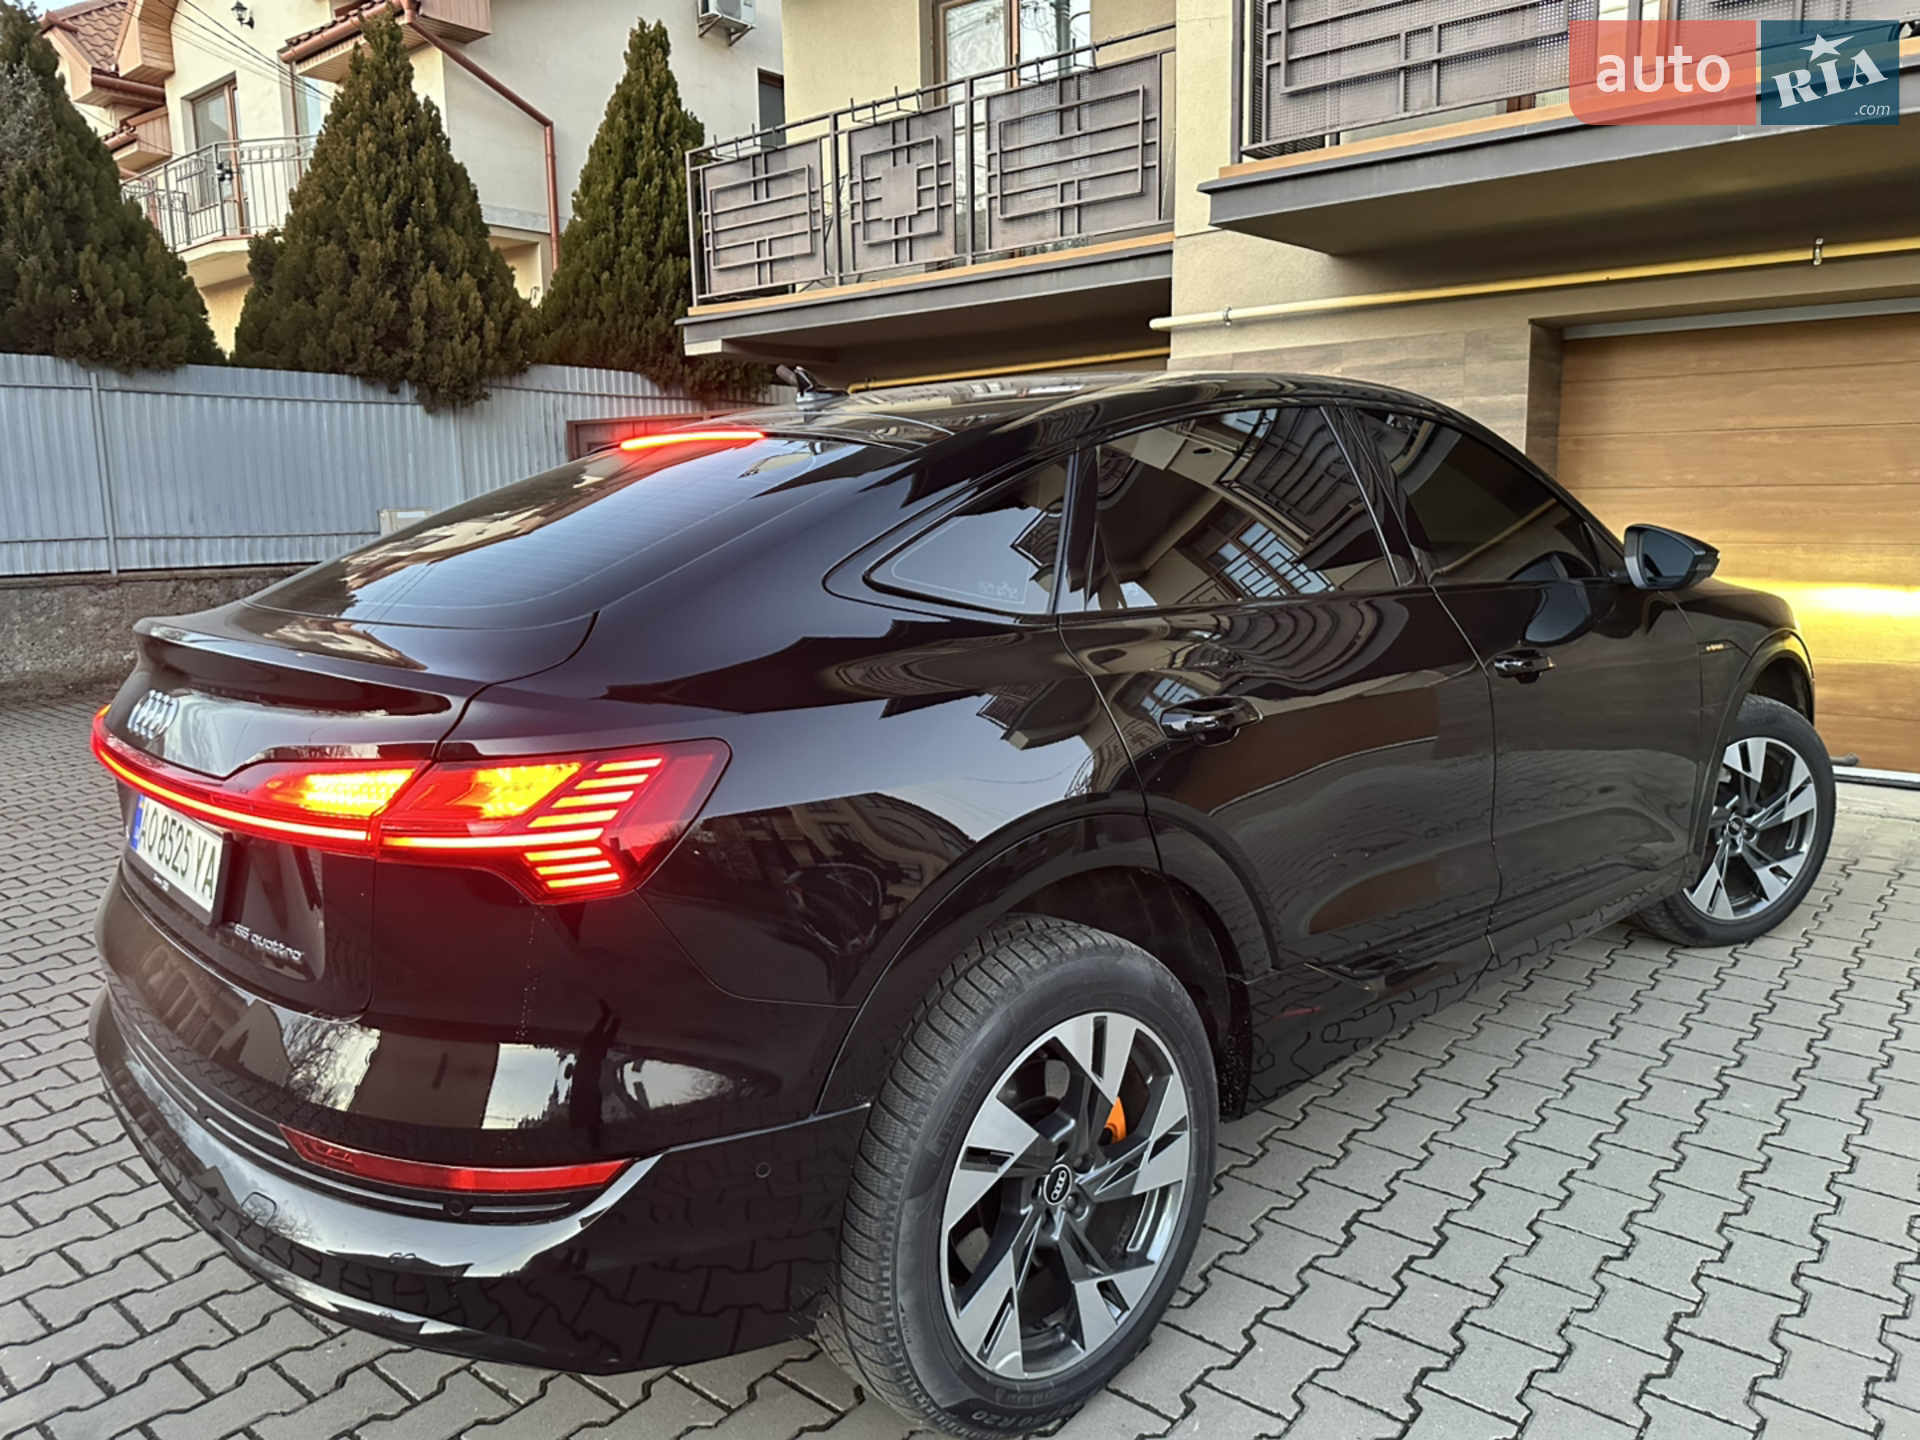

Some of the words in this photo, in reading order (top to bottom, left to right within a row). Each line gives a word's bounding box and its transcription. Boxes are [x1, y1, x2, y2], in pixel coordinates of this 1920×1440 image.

[157, 814, 192, 878] 8525
[194, 835, 217, 900] YA
[250, 932, 304, 961] quattro
